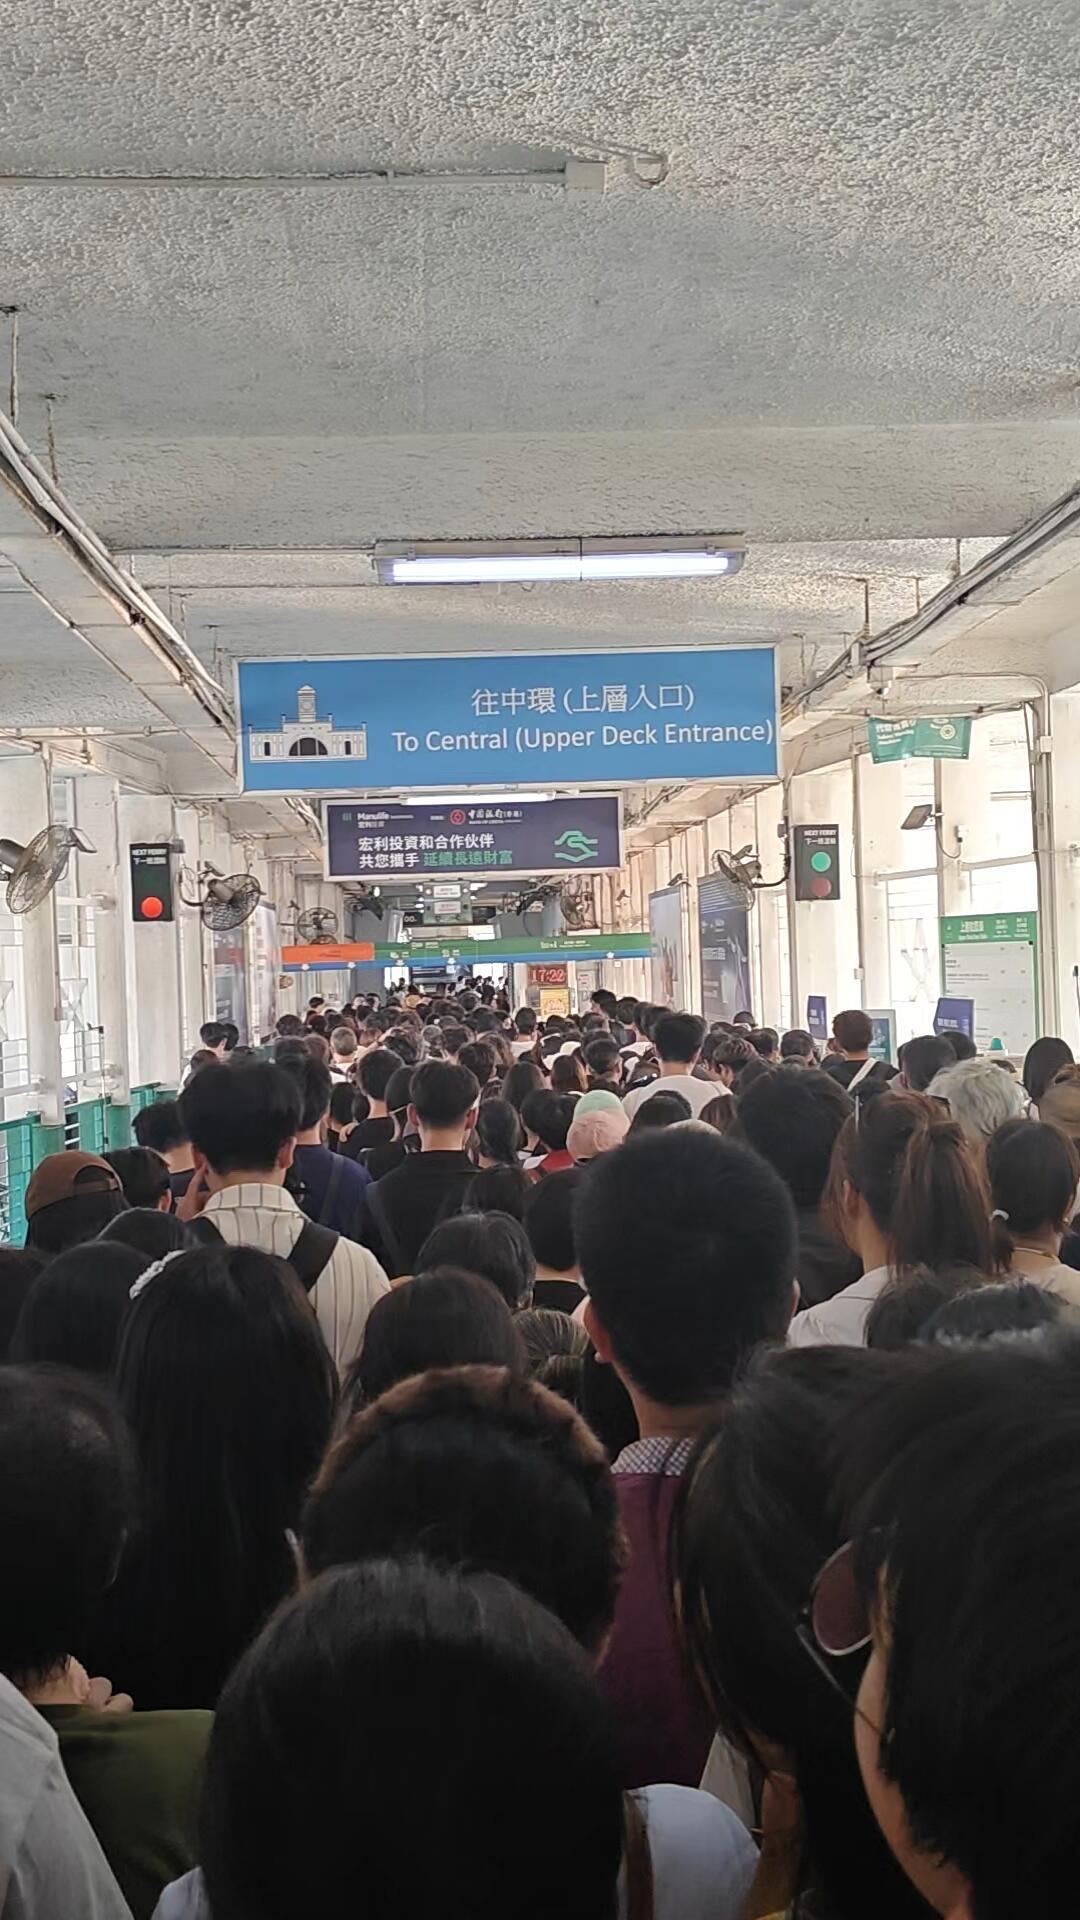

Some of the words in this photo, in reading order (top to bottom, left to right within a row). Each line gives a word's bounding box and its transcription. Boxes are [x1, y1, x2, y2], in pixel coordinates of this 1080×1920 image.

[391, 732, 420, 752] To
[425, 727, 508, 751] Central
[515, 726, 595, 752] (Upper
[602, 723, 658, 746] Deck
[664, 719, 774, 745] Entrance)
[358, 833, 495, 851] 宏利投資和合作伙伴
